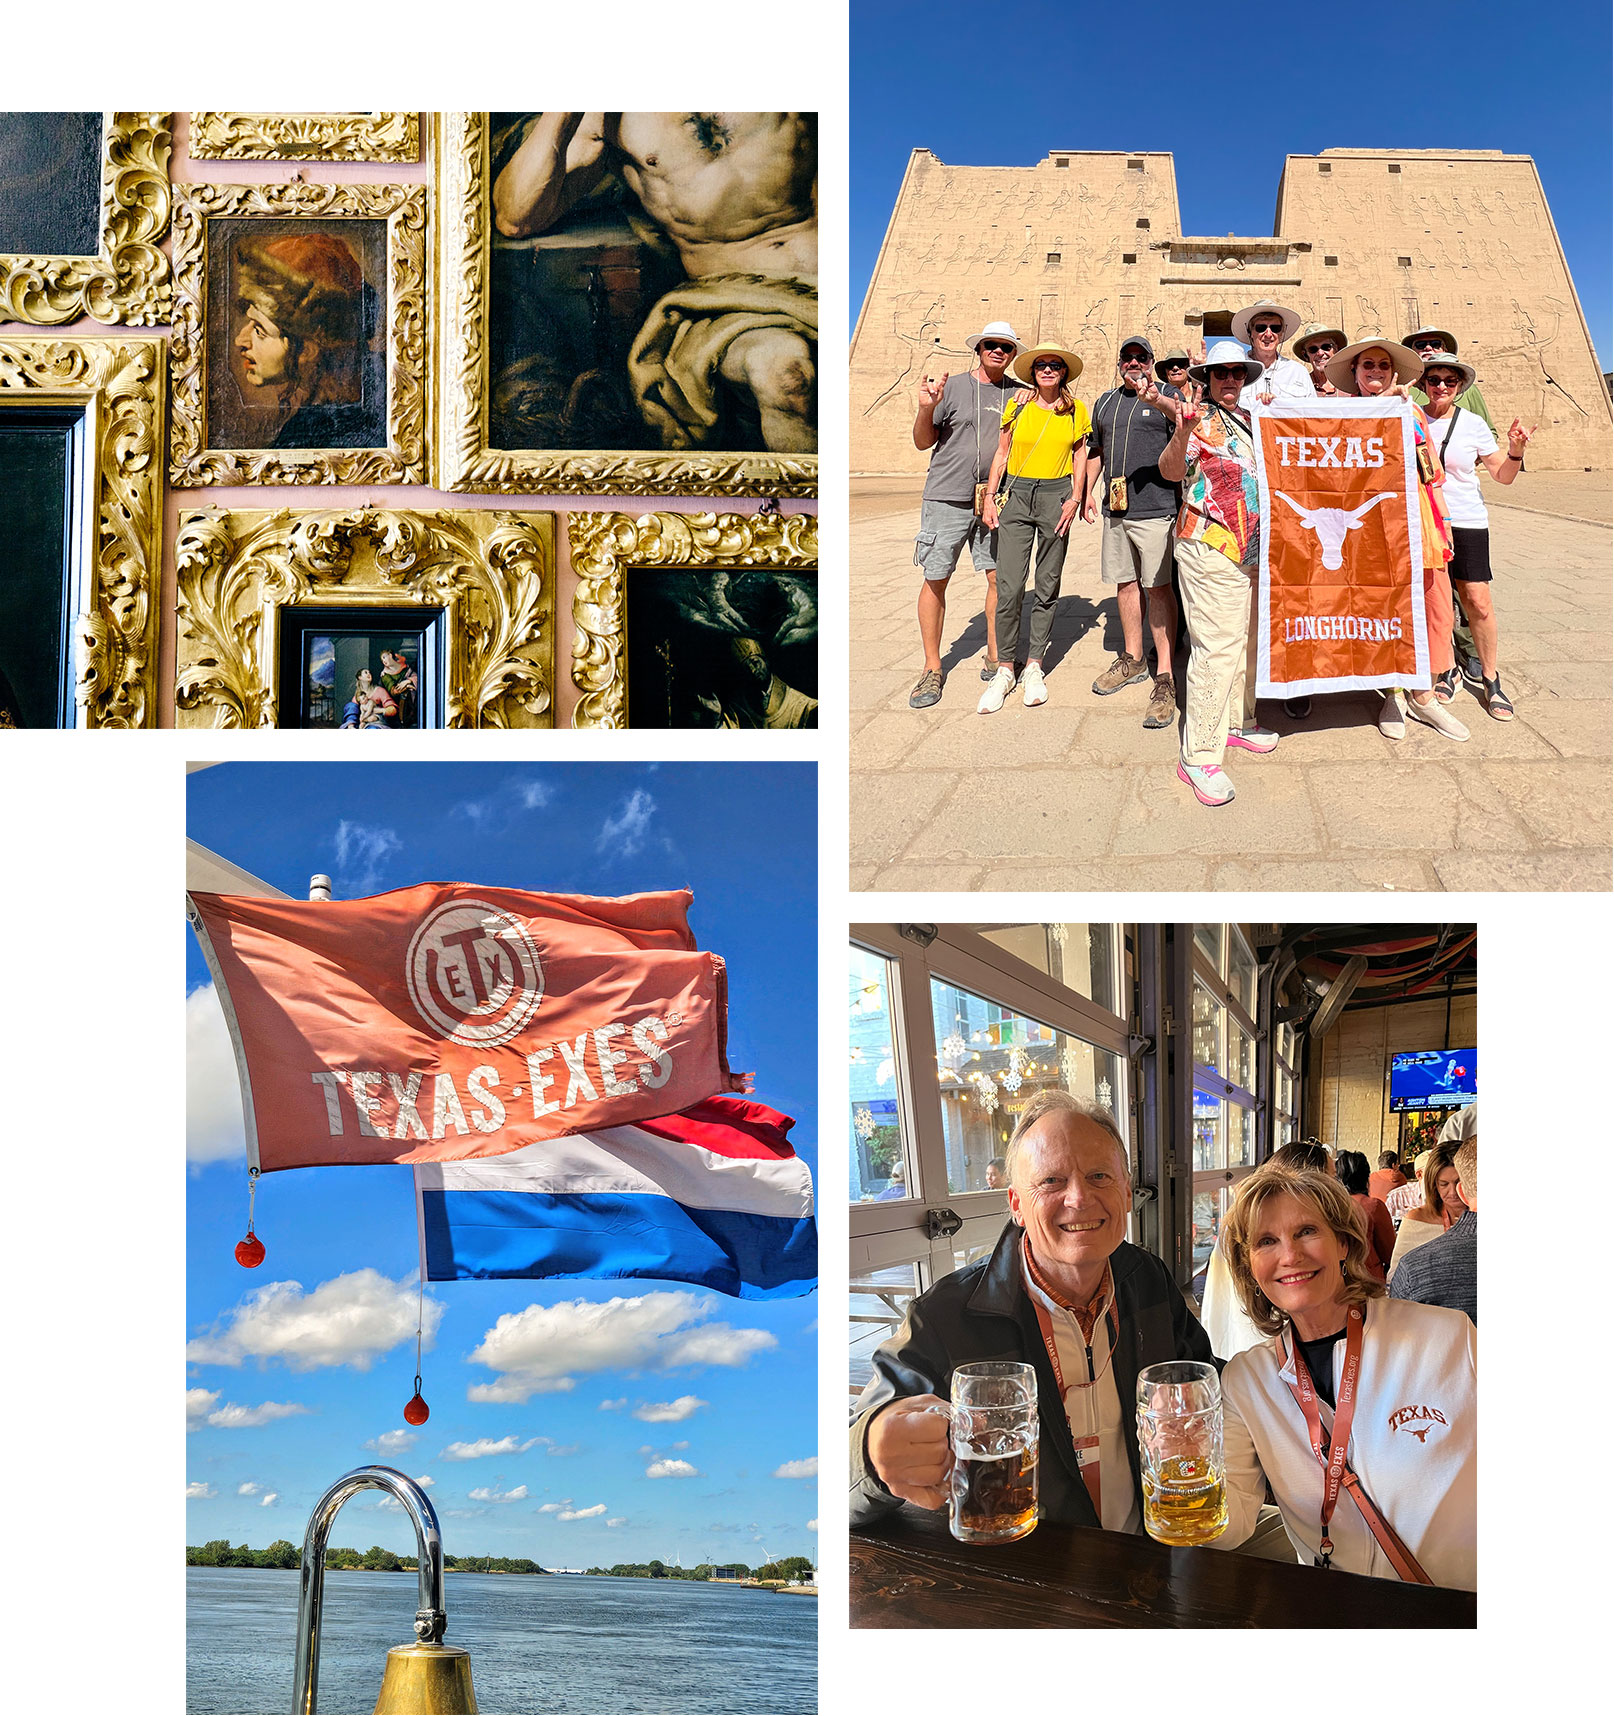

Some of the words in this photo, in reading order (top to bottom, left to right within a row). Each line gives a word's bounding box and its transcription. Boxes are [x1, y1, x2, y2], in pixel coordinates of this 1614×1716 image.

[1275, 436, 1384, 468] TEXAS
[1285, 616, 1403, 643] LONGHORNS
[311, 1065, 507, 1140] TEXAS
[1340, 1355, 1360, 1403] TexasExes.org
[1388, 1404, 1447, 1431] TEXAS
[1329, 1478, 1339, 1502] TEXAS
[1334, 1446, 1345, 1465] EXES
